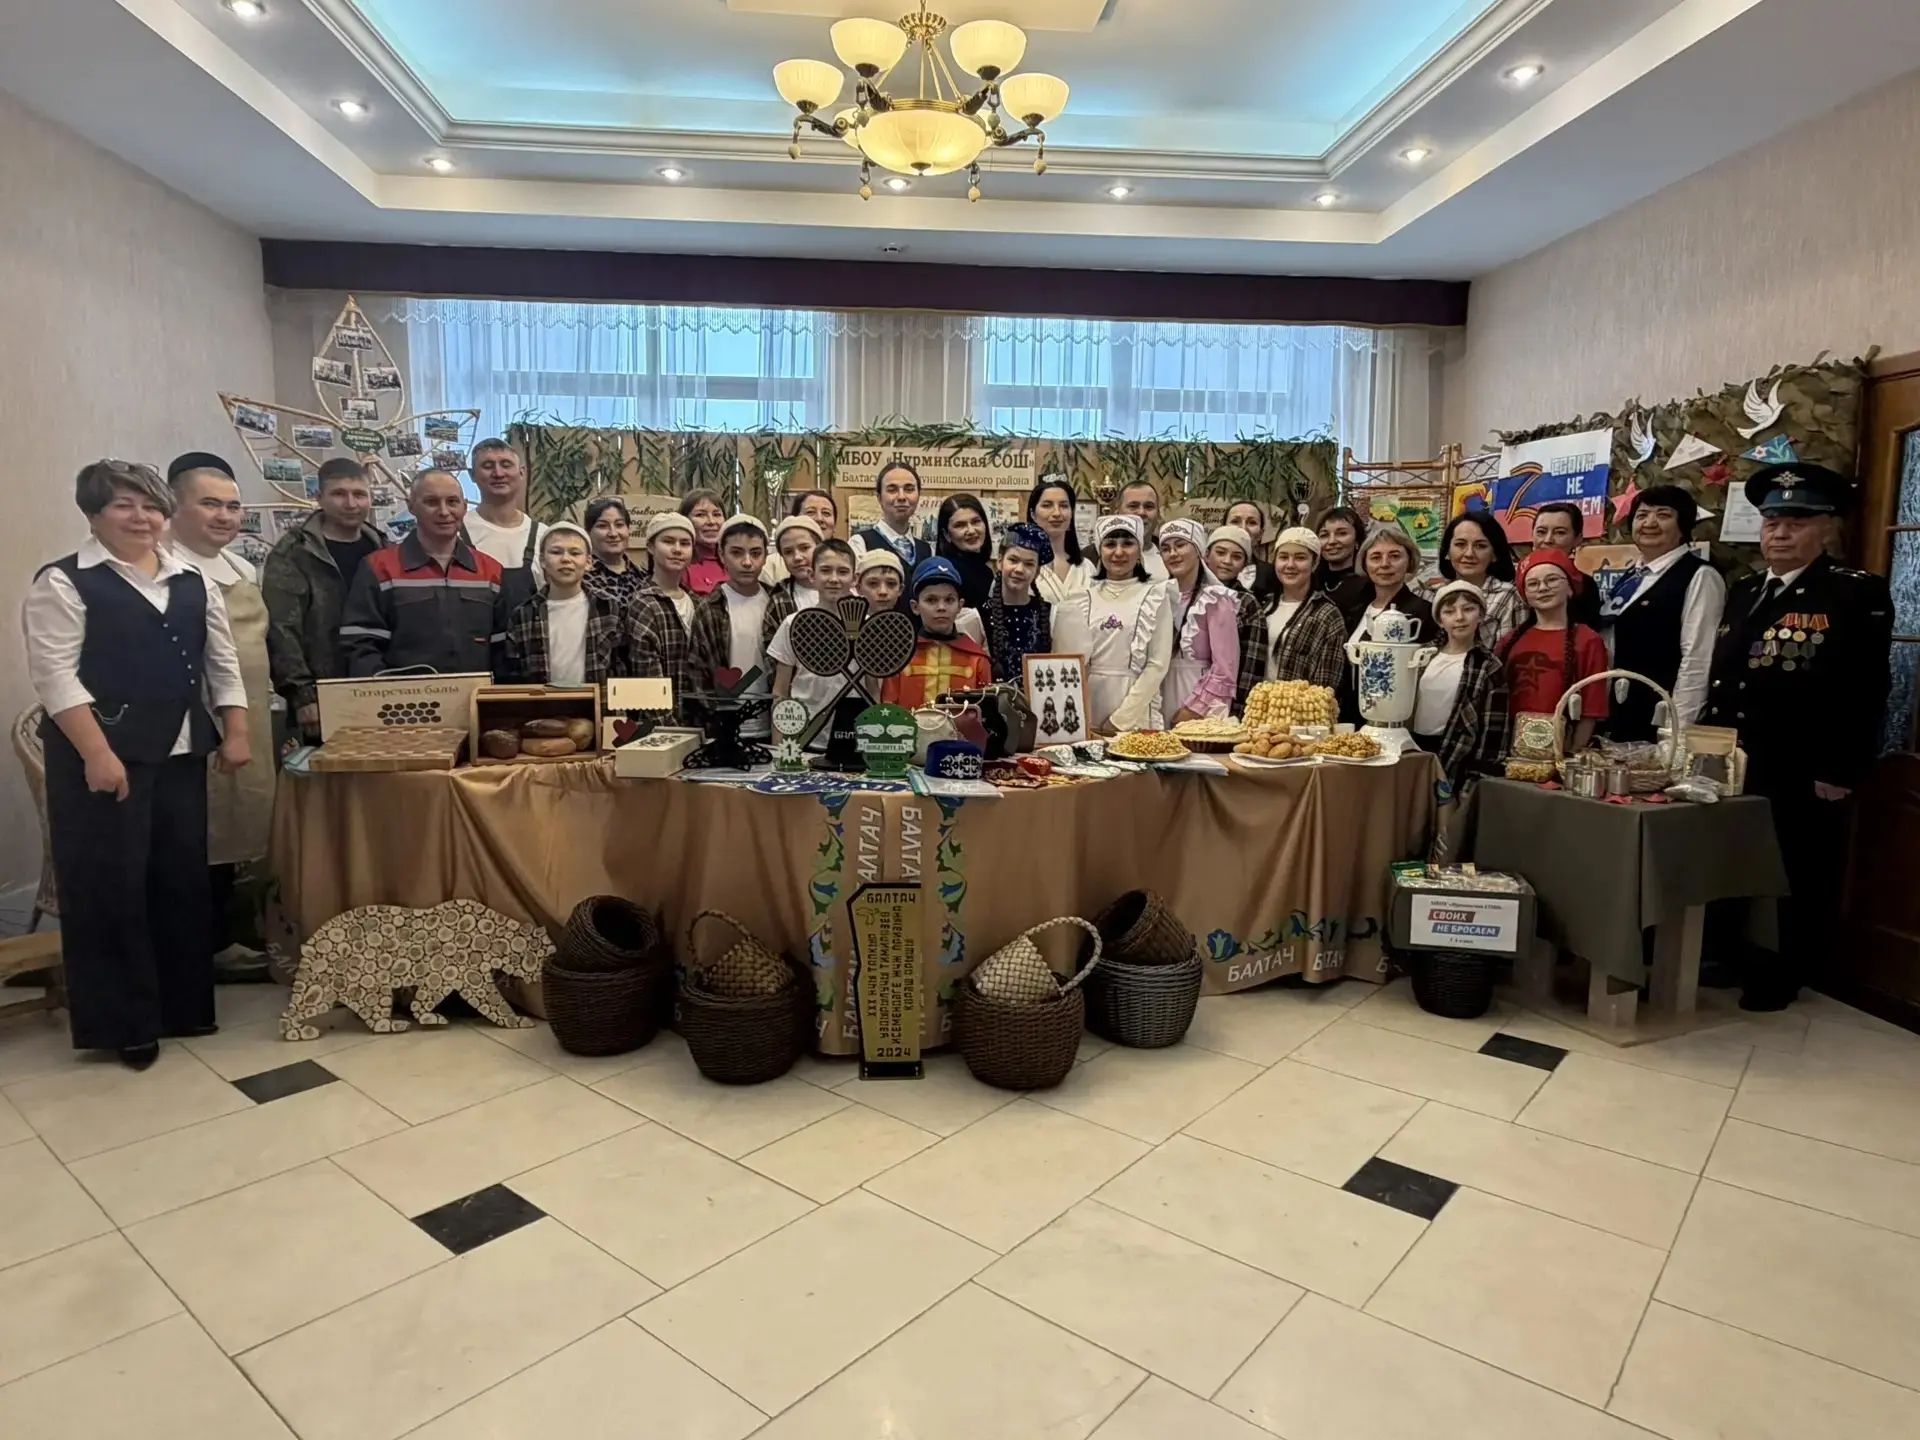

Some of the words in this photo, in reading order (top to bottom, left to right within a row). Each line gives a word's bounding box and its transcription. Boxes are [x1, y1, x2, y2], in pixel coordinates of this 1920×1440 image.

[838, 451, 881, 466] МБОУ
[842, 472, 877, 483] Балтас
[919, 475, 993, 486] униципального
[996, 475, 1030, 488] района
[1566, 476, 1584, 495] НЕ
[351, 687, 421, 698] Татарстан
[856, 806, 881, 889] АЛТАЧ
[901, 806, 921, 883] БАЛТА
[867, 892, 916, 904] БАЛТАЧ
[1432, 911, 1467, 921] СВОИХ
[1436, 924, 1449, 933] НЕ
[1451, 925, 1496, 936] БРОСАЕМ
[1227, 945, 1294, 983] БАЛТАЧ
[877, 1047, 911, 1058] 2024
